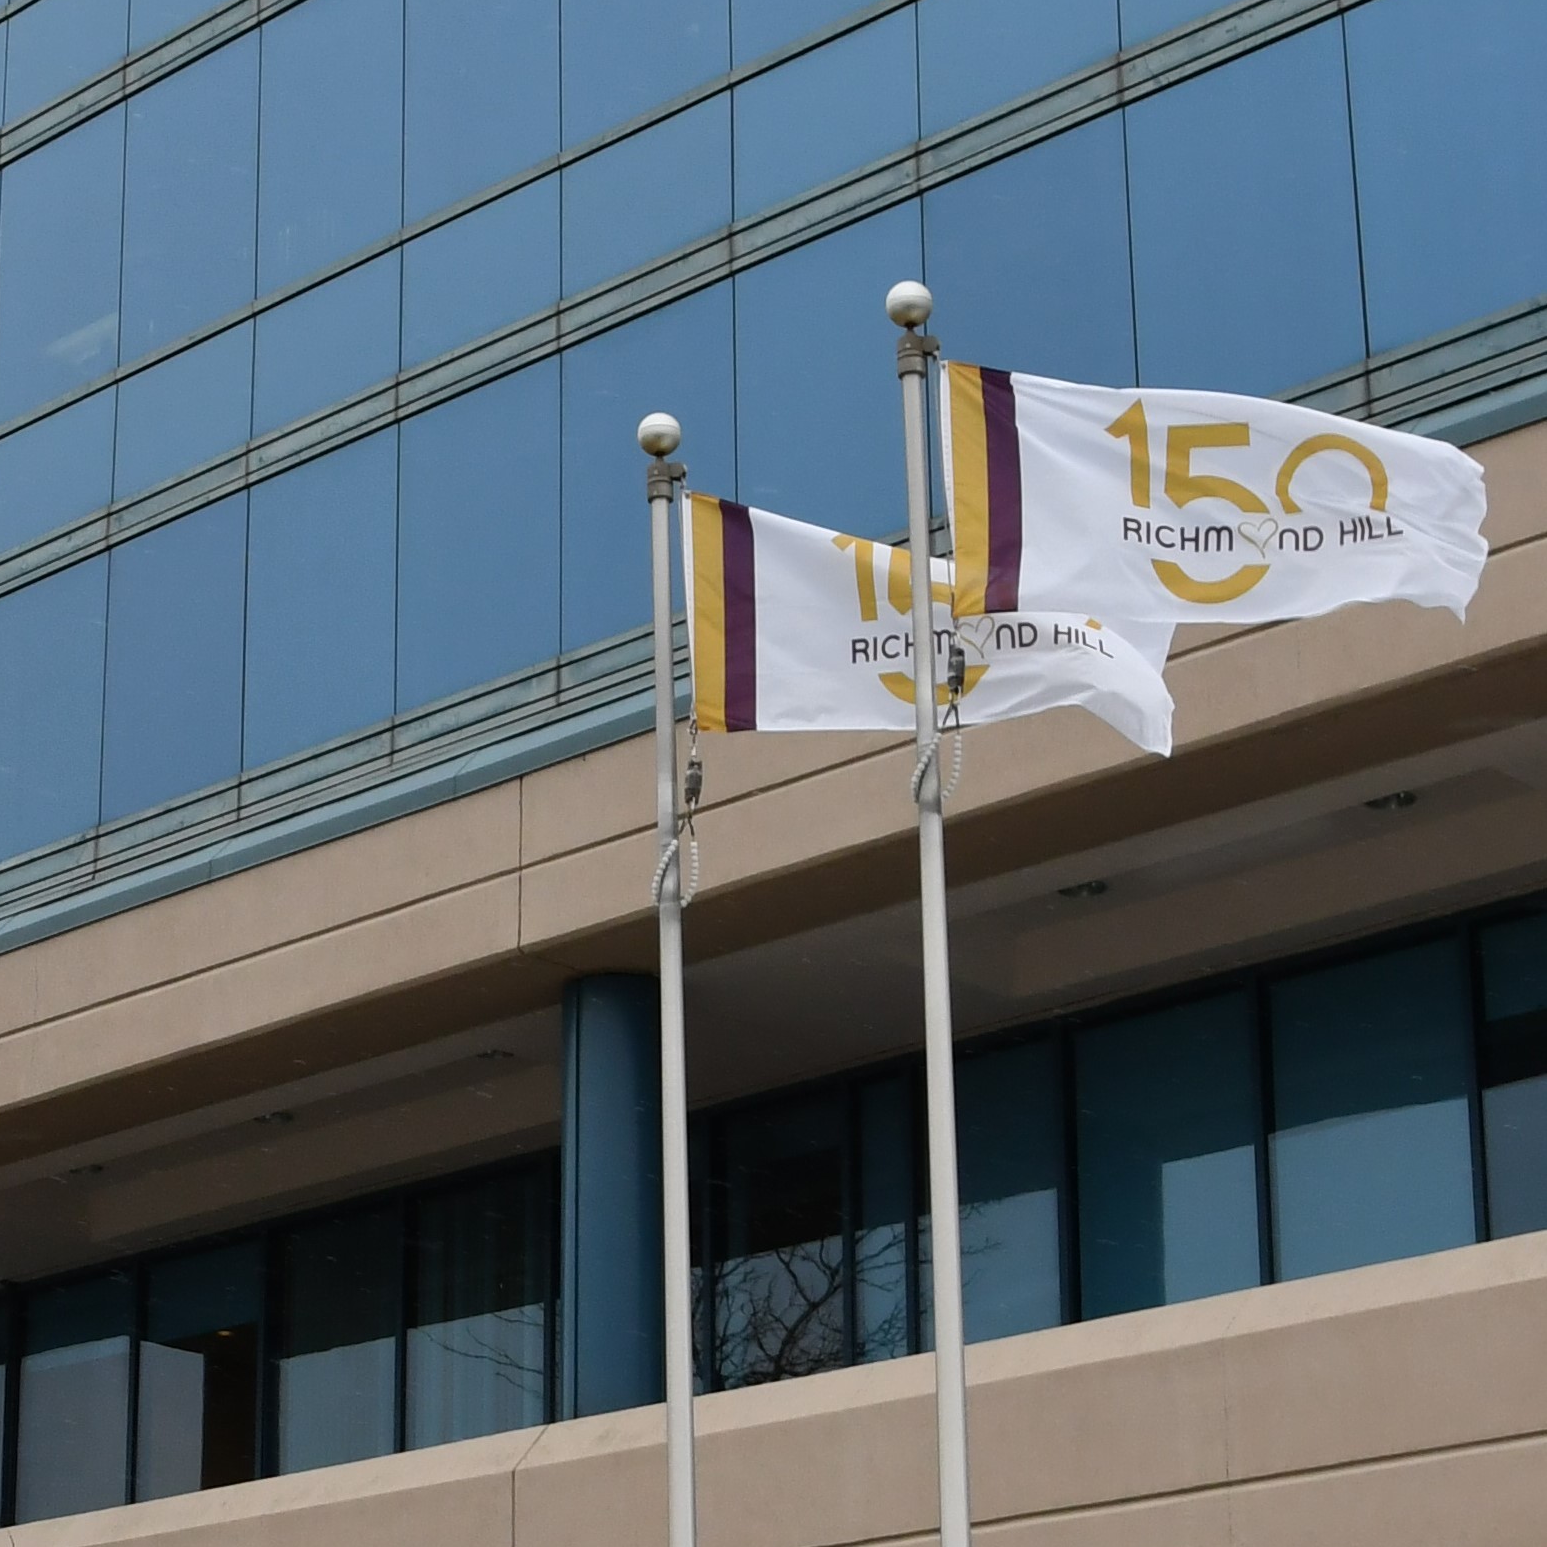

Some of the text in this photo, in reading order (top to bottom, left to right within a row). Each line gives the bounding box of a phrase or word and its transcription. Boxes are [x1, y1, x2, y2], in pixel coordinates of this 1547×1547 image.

[1105, 399, 1389, 514] 150
[1338, 516, 1403, 547] HILL
[1053, 624, 1114, 659] HILL
